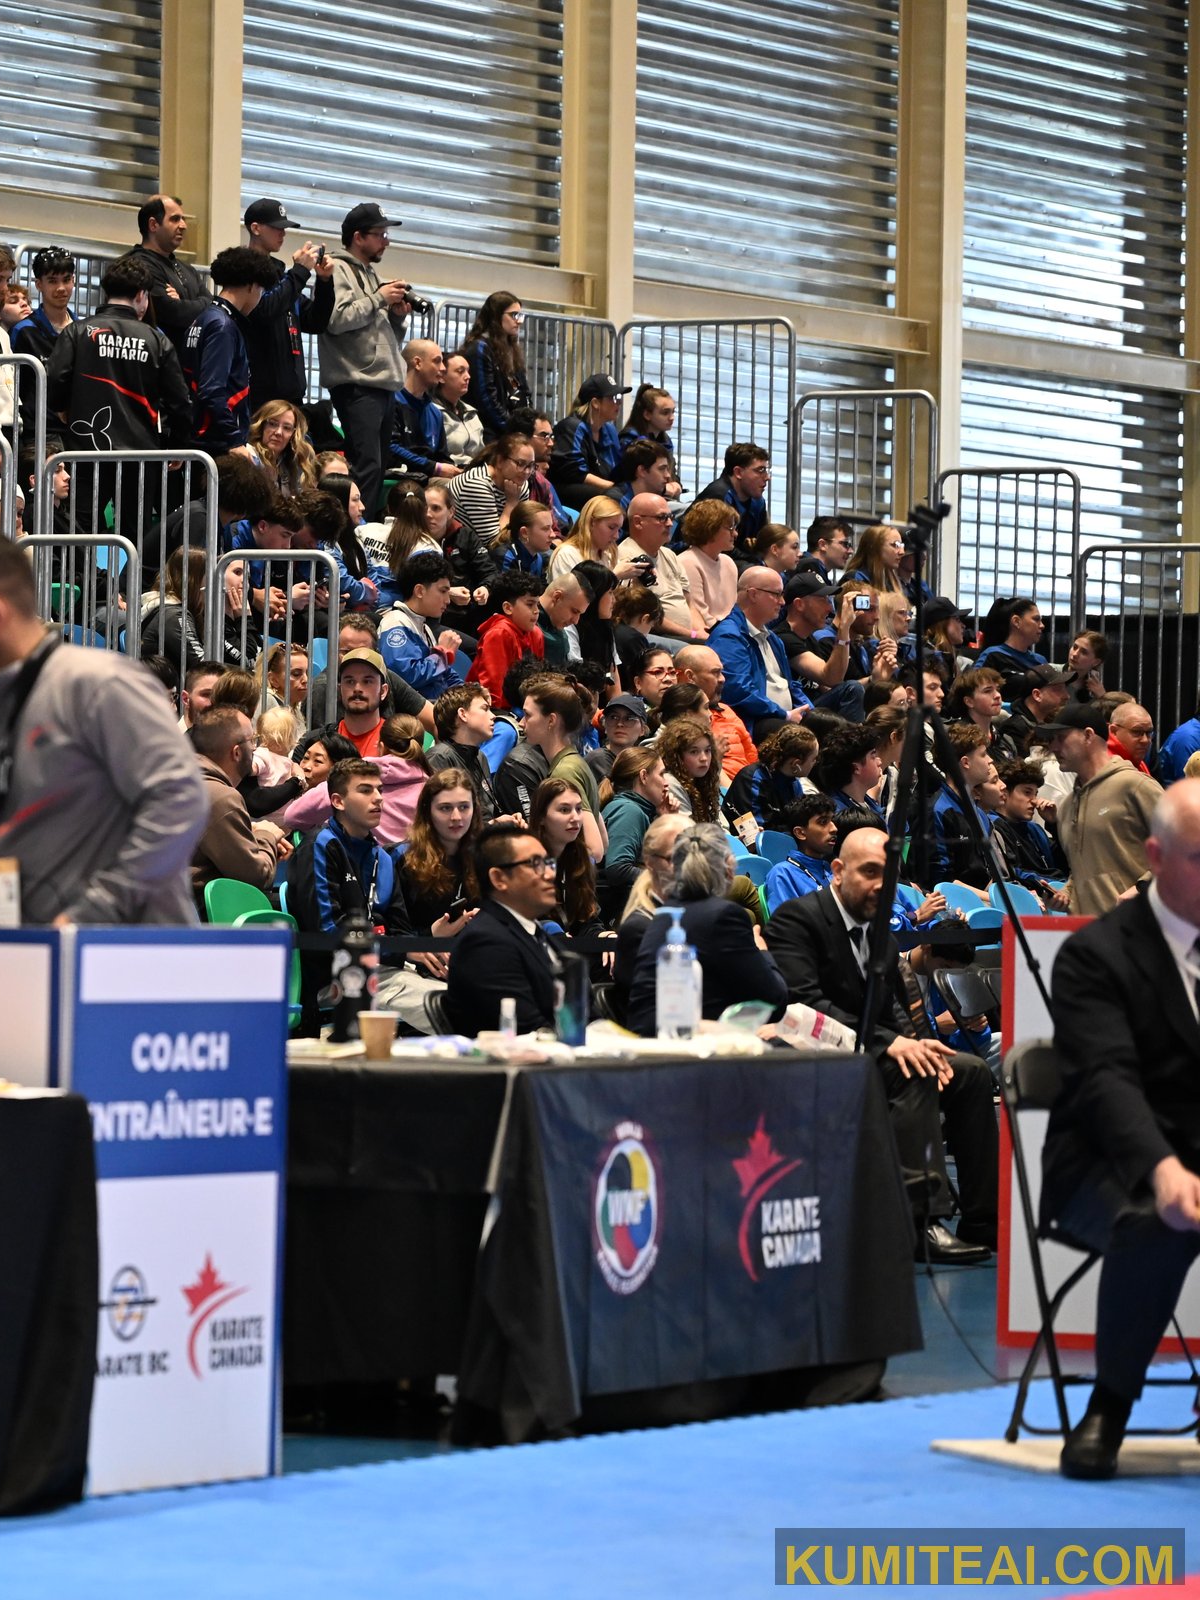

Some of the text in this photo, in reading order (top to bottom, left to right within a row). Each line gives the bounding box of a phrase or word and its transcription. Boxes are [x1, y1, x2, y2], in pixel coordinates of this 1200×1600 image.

[98, 334, 146, 350] KARATE
[98, 346, 149, 363] ONTARIO
[131, 1032, 230, 1073] COACH
[89, 1089, 274, 1142] NTRAÎNEUR·E
[761, 1196, 820, 1234] KARATE
[761, 1230, 821, 1269] CANADA
[209, 1315, 264, 1342] KARATE
[96, 1350, 169, 1378] ARATE BC
[209, 1345, 264, 1371] CANADA
